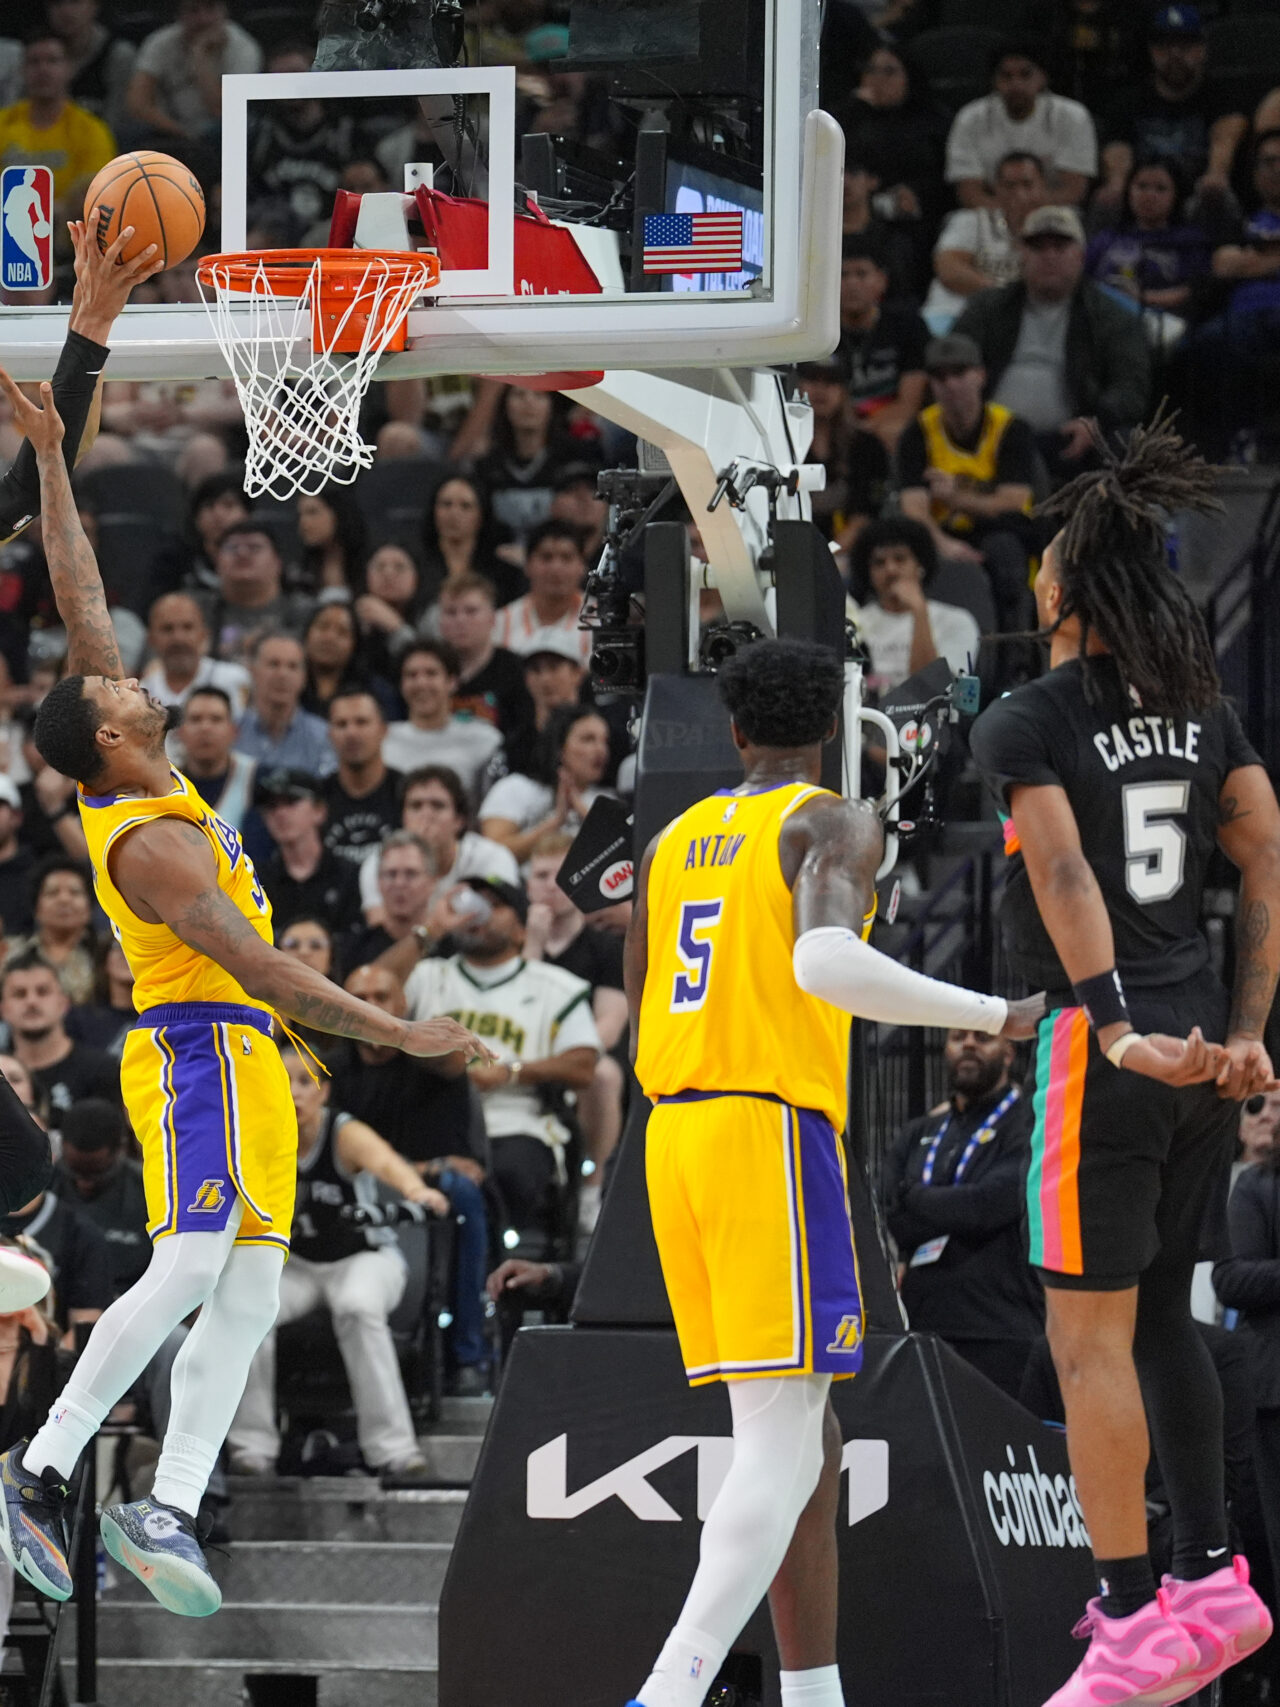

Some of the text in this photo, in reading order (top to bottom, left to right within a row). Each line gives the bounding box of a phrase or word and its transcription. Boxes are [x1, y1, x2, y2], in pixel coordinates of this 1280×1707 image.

[7, 262, 32, 282] NBA
[1093, 715, 1201, 772] CASTLE
[684, 833, 746, 871] AYTON
[1122, 780, 1191, 904] 5
[669, 896, 724, 1014] 5
